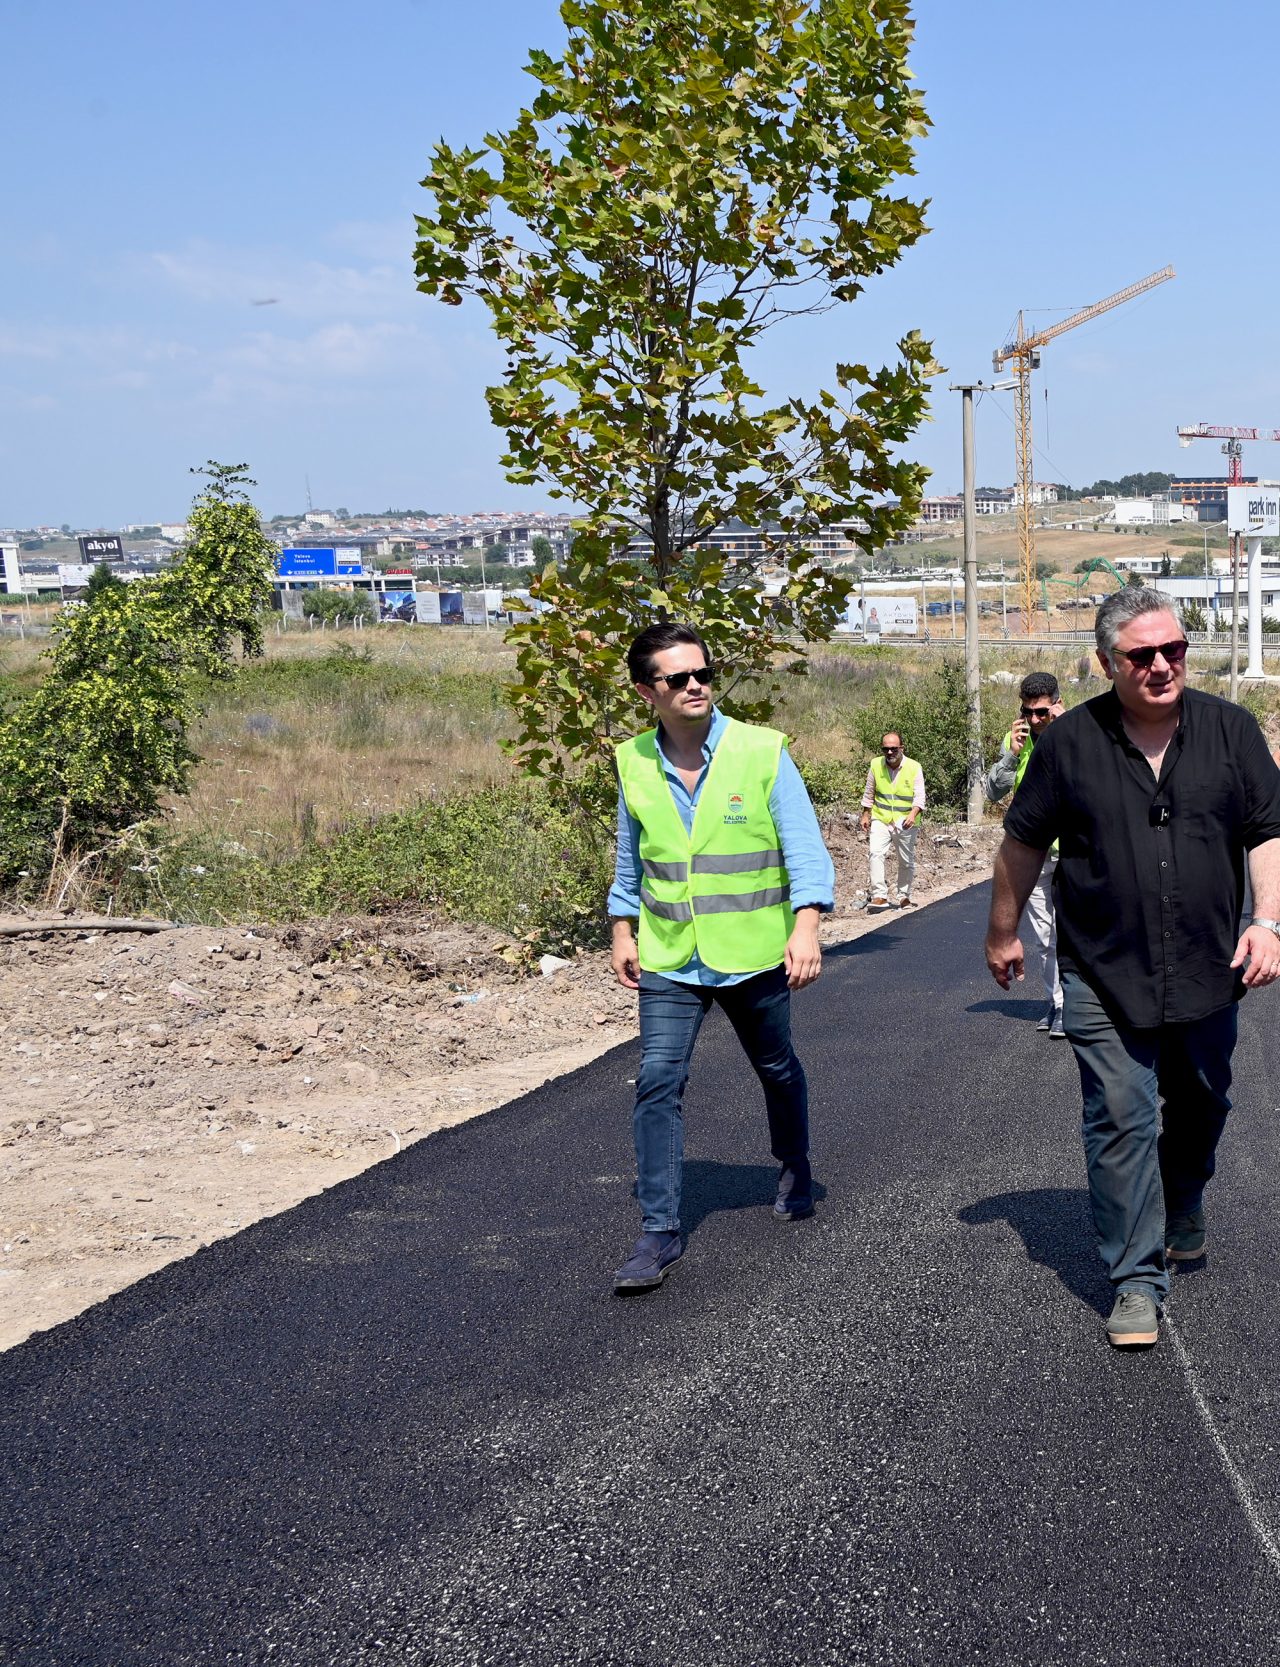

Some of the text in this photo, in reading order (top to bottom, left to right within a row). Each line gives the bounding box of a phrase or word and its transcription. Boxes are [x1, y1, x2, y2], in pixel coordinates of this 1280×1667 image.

[1248, 496, 1276, 522] park inn
[87, 540, 118, 552] akyol
